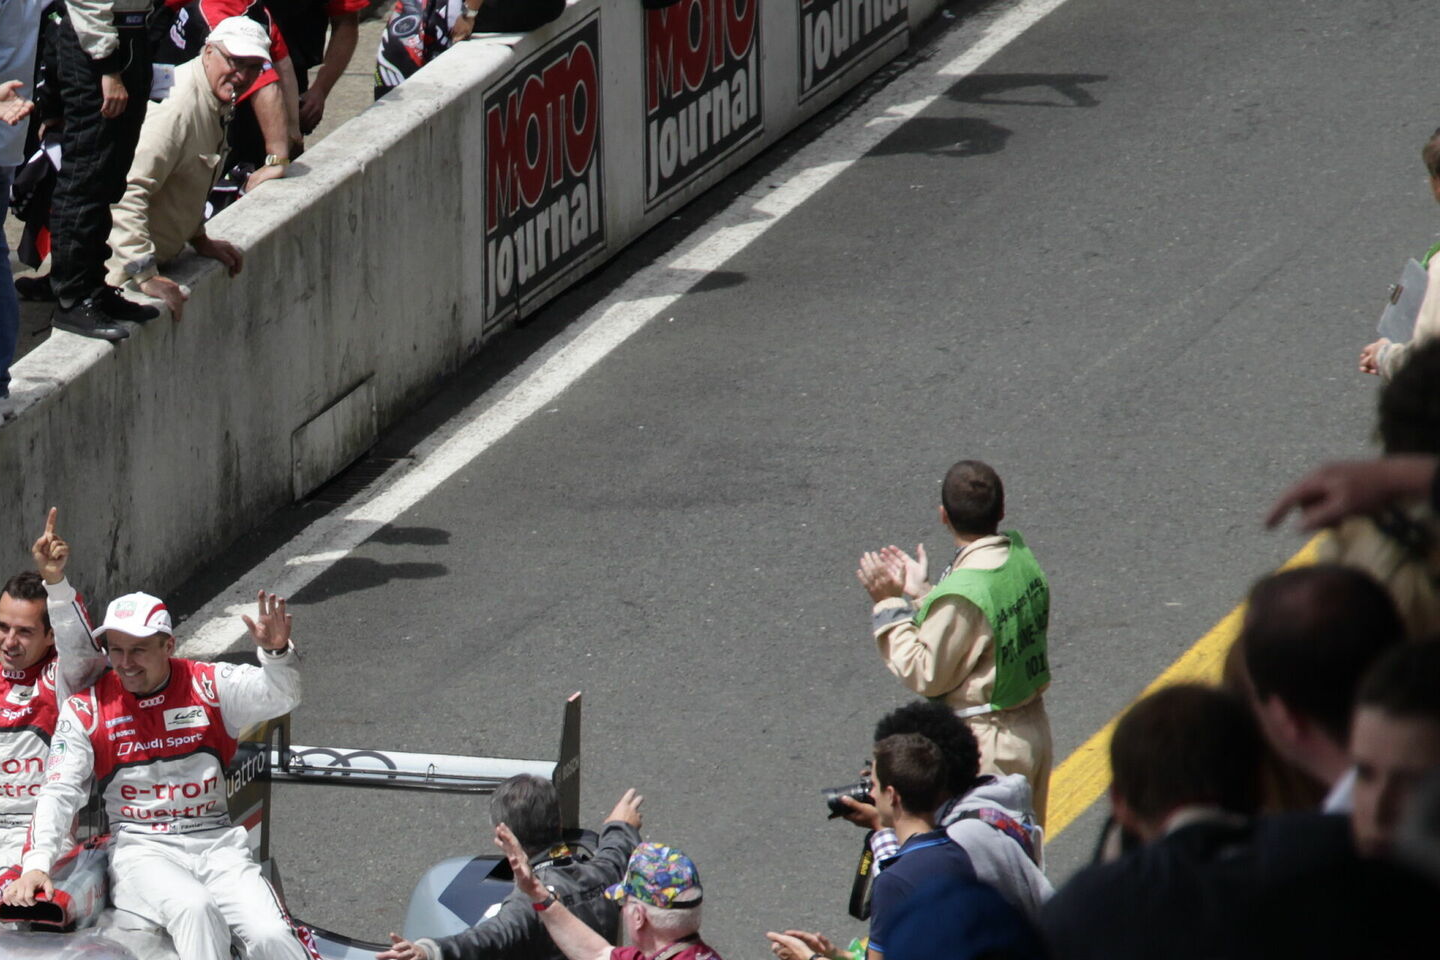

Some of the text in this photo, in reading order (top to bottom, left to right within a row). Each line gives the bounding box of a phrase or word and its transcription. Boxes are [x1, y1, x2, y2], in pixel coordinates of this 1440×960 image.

[802, 0, 908, 94] journ
[485, 40, 599, 237] MOTO
[647, 40, 759, 201] journal
[484, 150, 601, 322] journal
[120, 776, 219, 801] e-tron
[134, 733, 203, 752] Audi Sport
[226, 750, 266, 799] uattro
